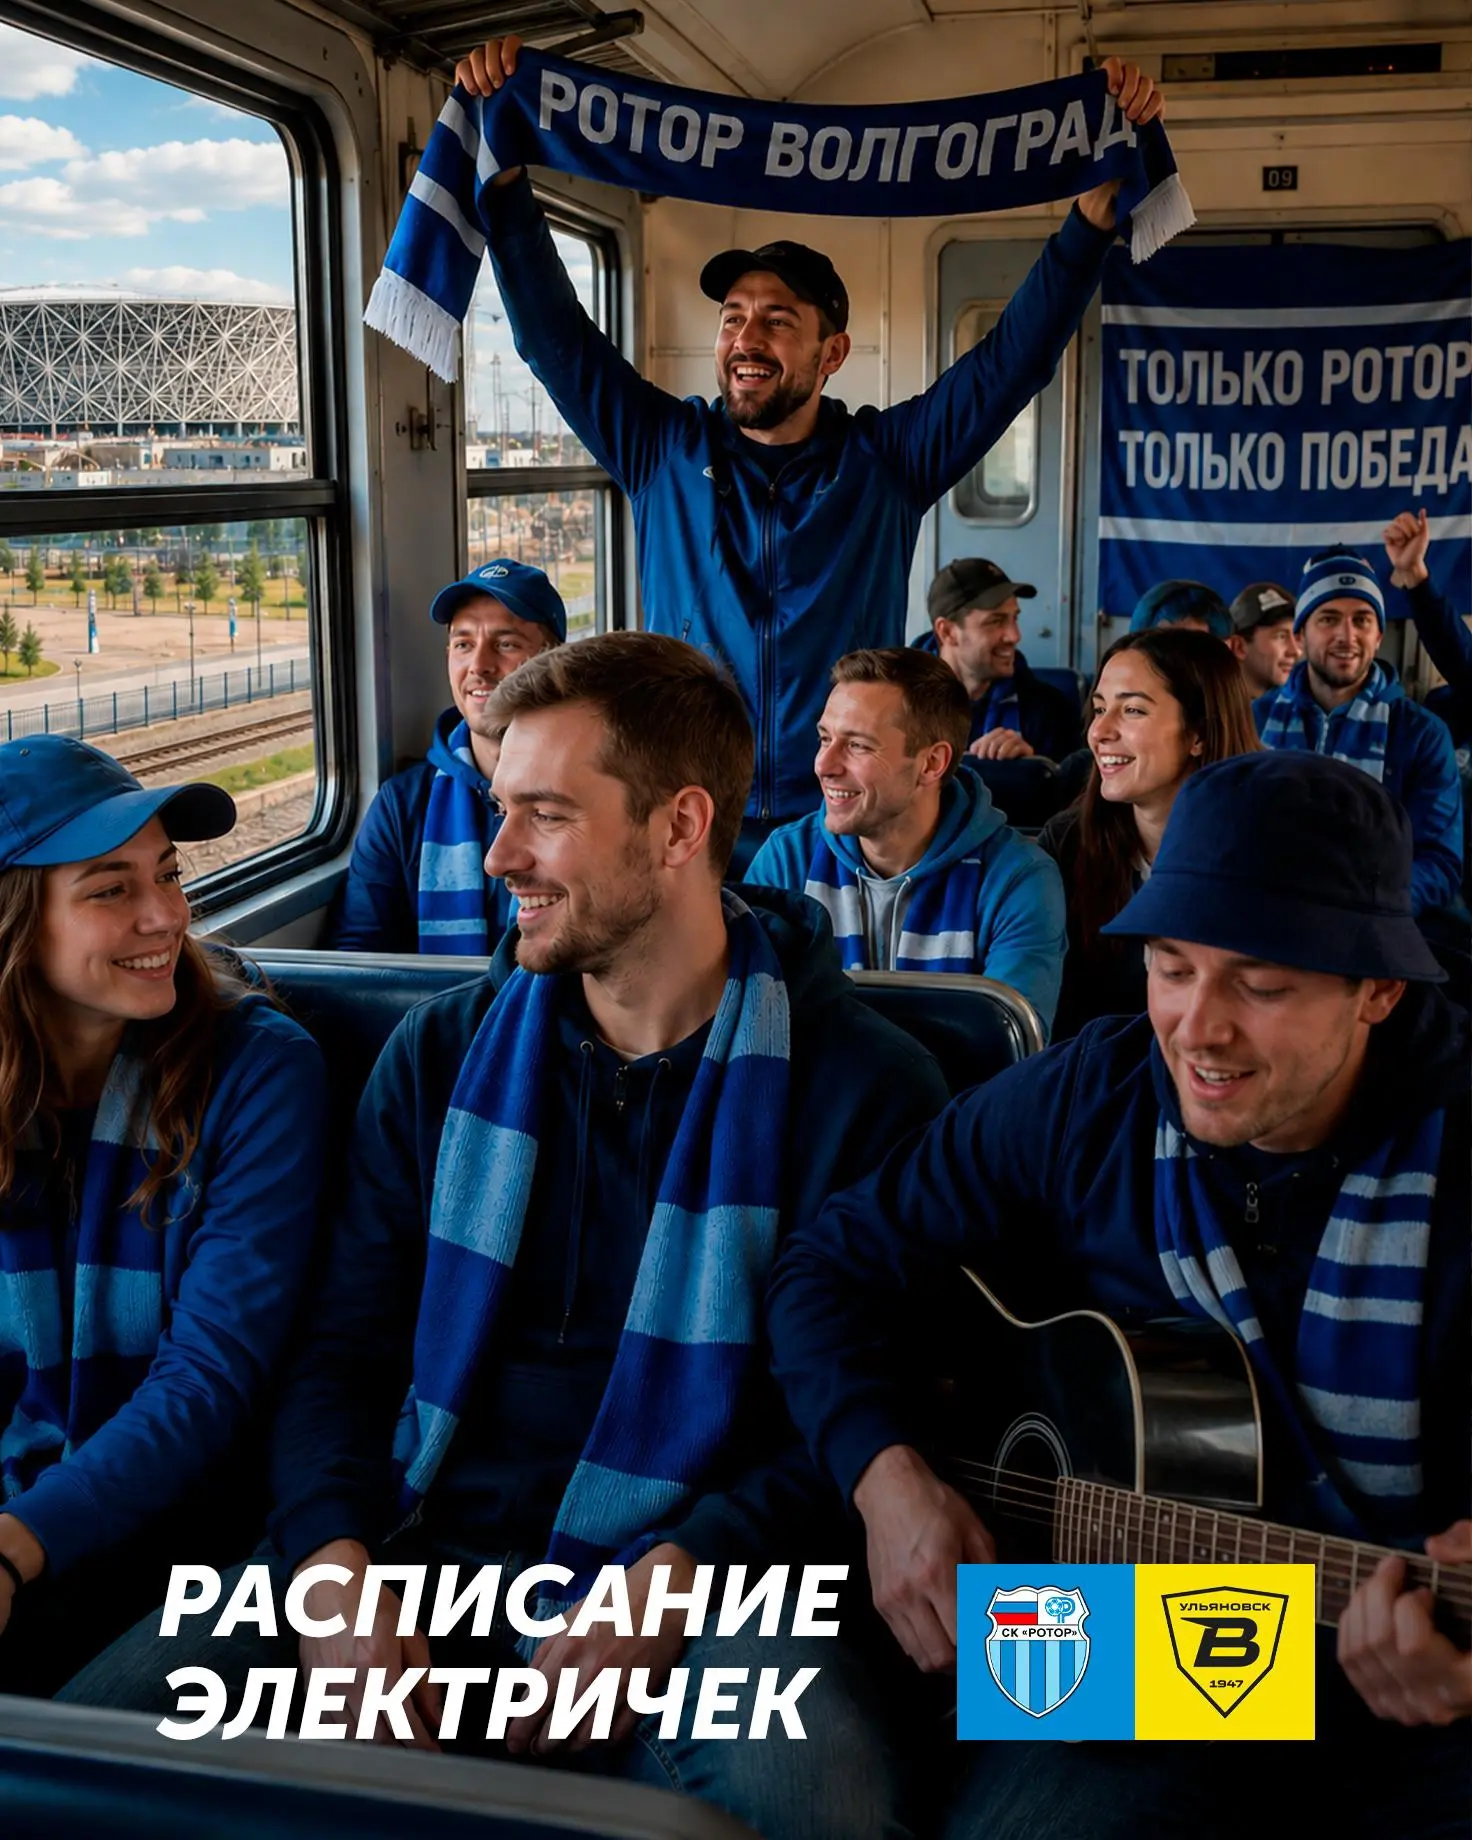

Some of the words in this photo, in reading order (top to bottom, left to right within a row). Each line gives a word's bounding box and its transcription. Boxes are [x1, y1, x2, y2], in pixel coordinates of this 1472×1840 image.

[539, 69, 745, 168] РОТОР
[765, 93, 1137, 183] ВОЛГОГРАД
[1267, 170, 1293, 187] 09
[1120, 348, 1304, 406] ТОЛЬКО
[1321, 341, 1472, 405] РОТОР
[1119, 430, 1286, 491] ТОЛЬКО
[1300, 424, 1472, 496] ПОБЕДА
